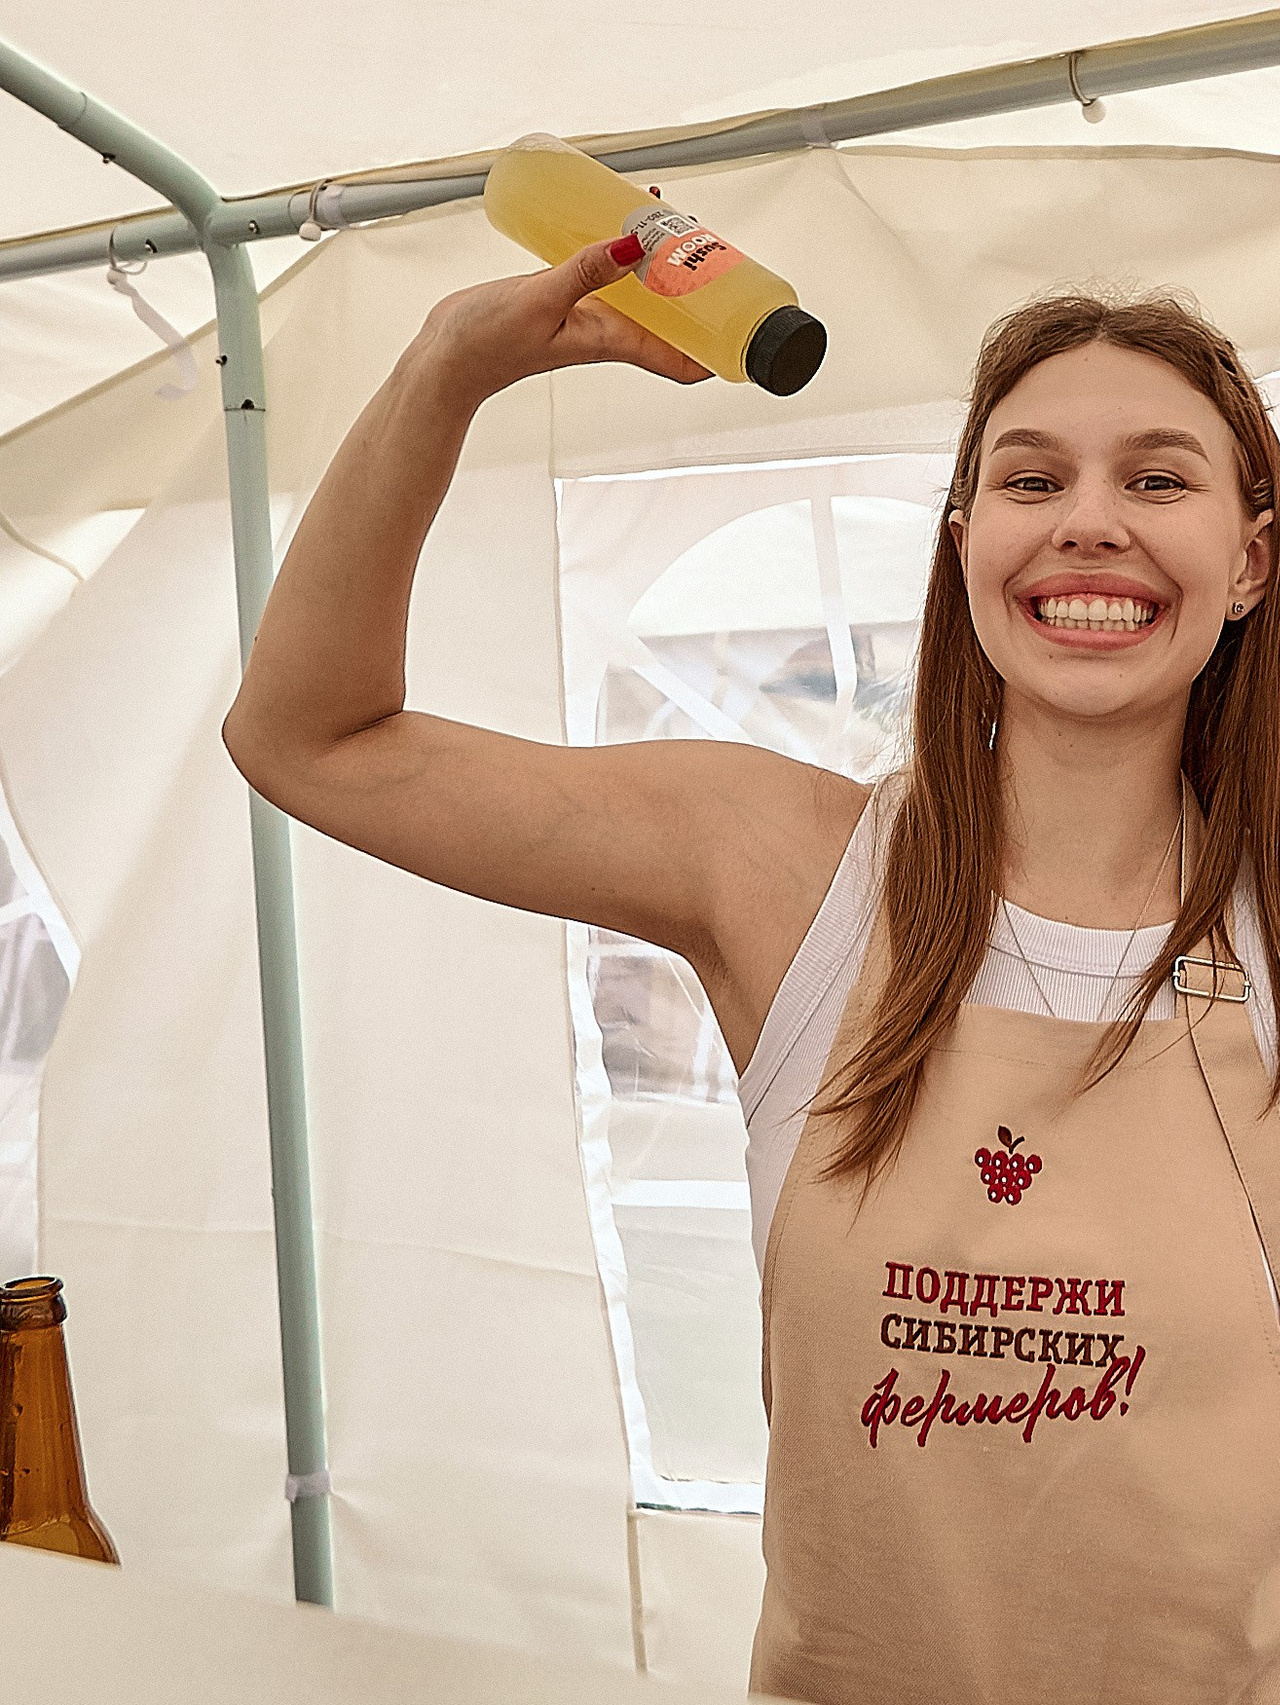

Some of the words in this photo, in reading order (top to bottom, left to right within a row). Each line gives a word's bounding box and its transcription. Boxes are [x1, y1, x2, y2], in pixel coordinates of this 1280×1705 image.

[882, 1261, 1126, 1317] ПОДДЕРЖИ
[880, 1313, 1125, 1367] СИБИРСКИХ
[860, 1345, 1147, 1449] фермеров!
